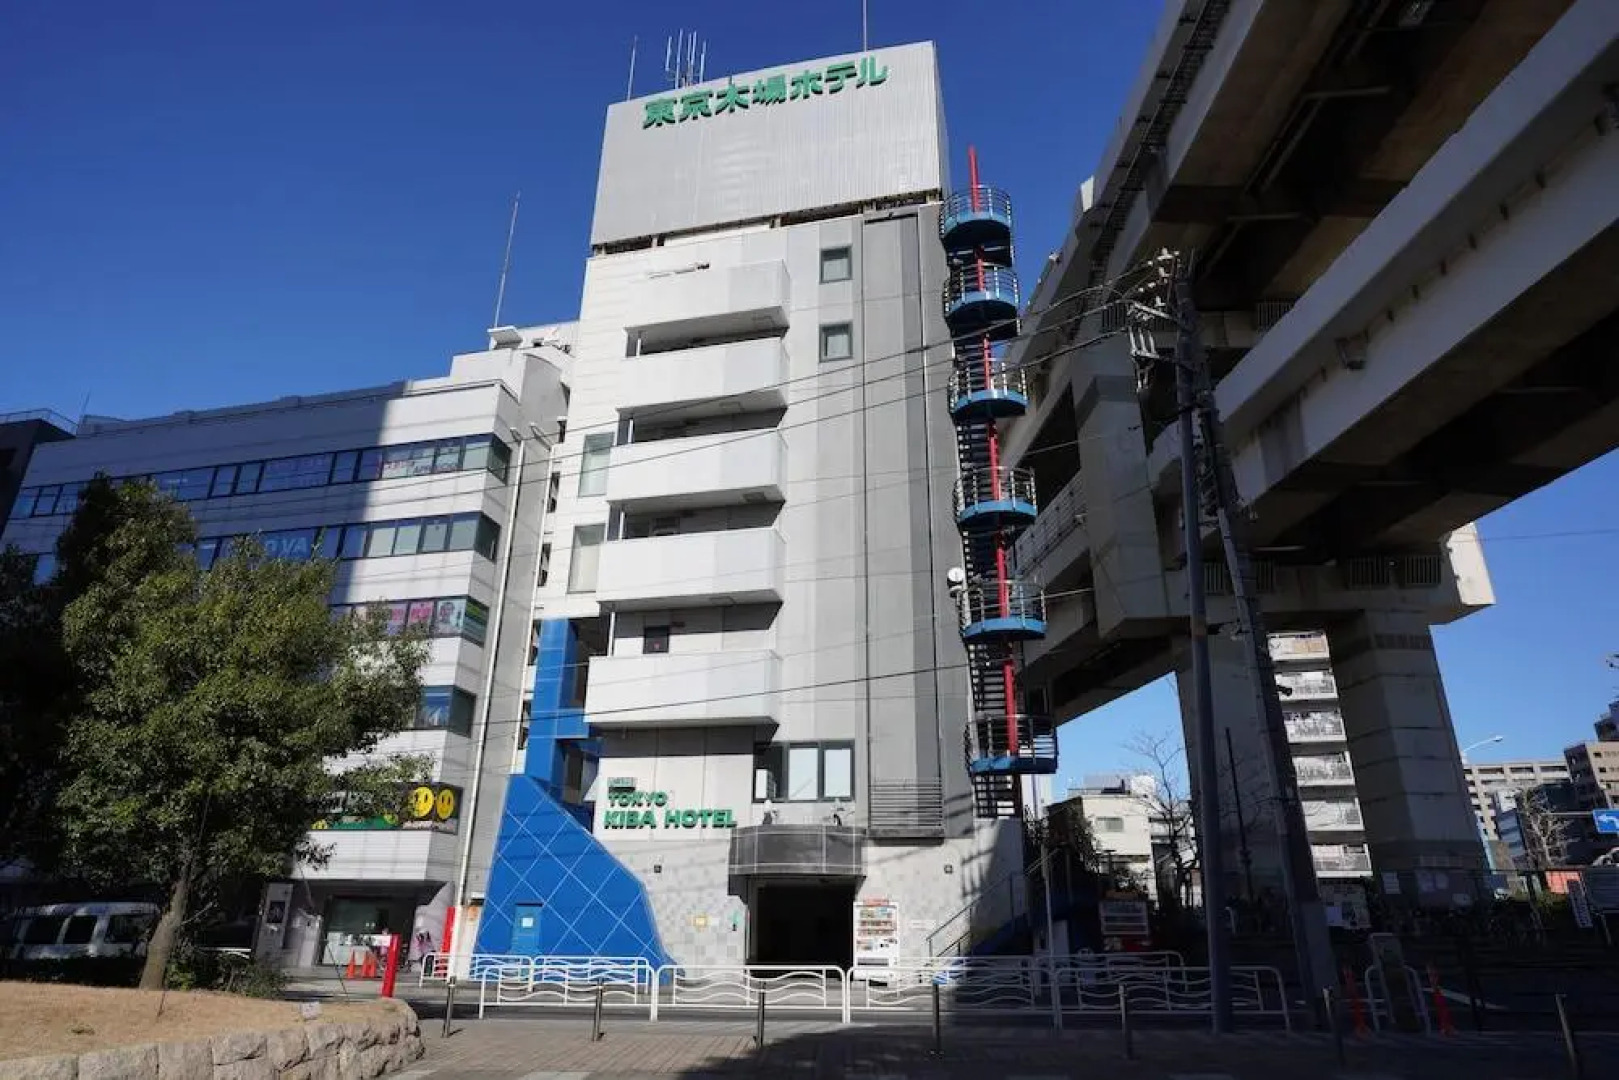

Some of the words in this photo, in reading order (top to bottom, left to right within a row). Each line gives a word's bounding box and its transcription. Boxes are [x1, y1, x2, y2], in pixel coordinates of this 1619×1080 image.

[643, 56, 889, 129] 東京木場ホテル
[608, 790, 668, 807] TOKYO
[604, 809, 657, 829] KIBA
[664, 809, 737, 829] HOTEL
